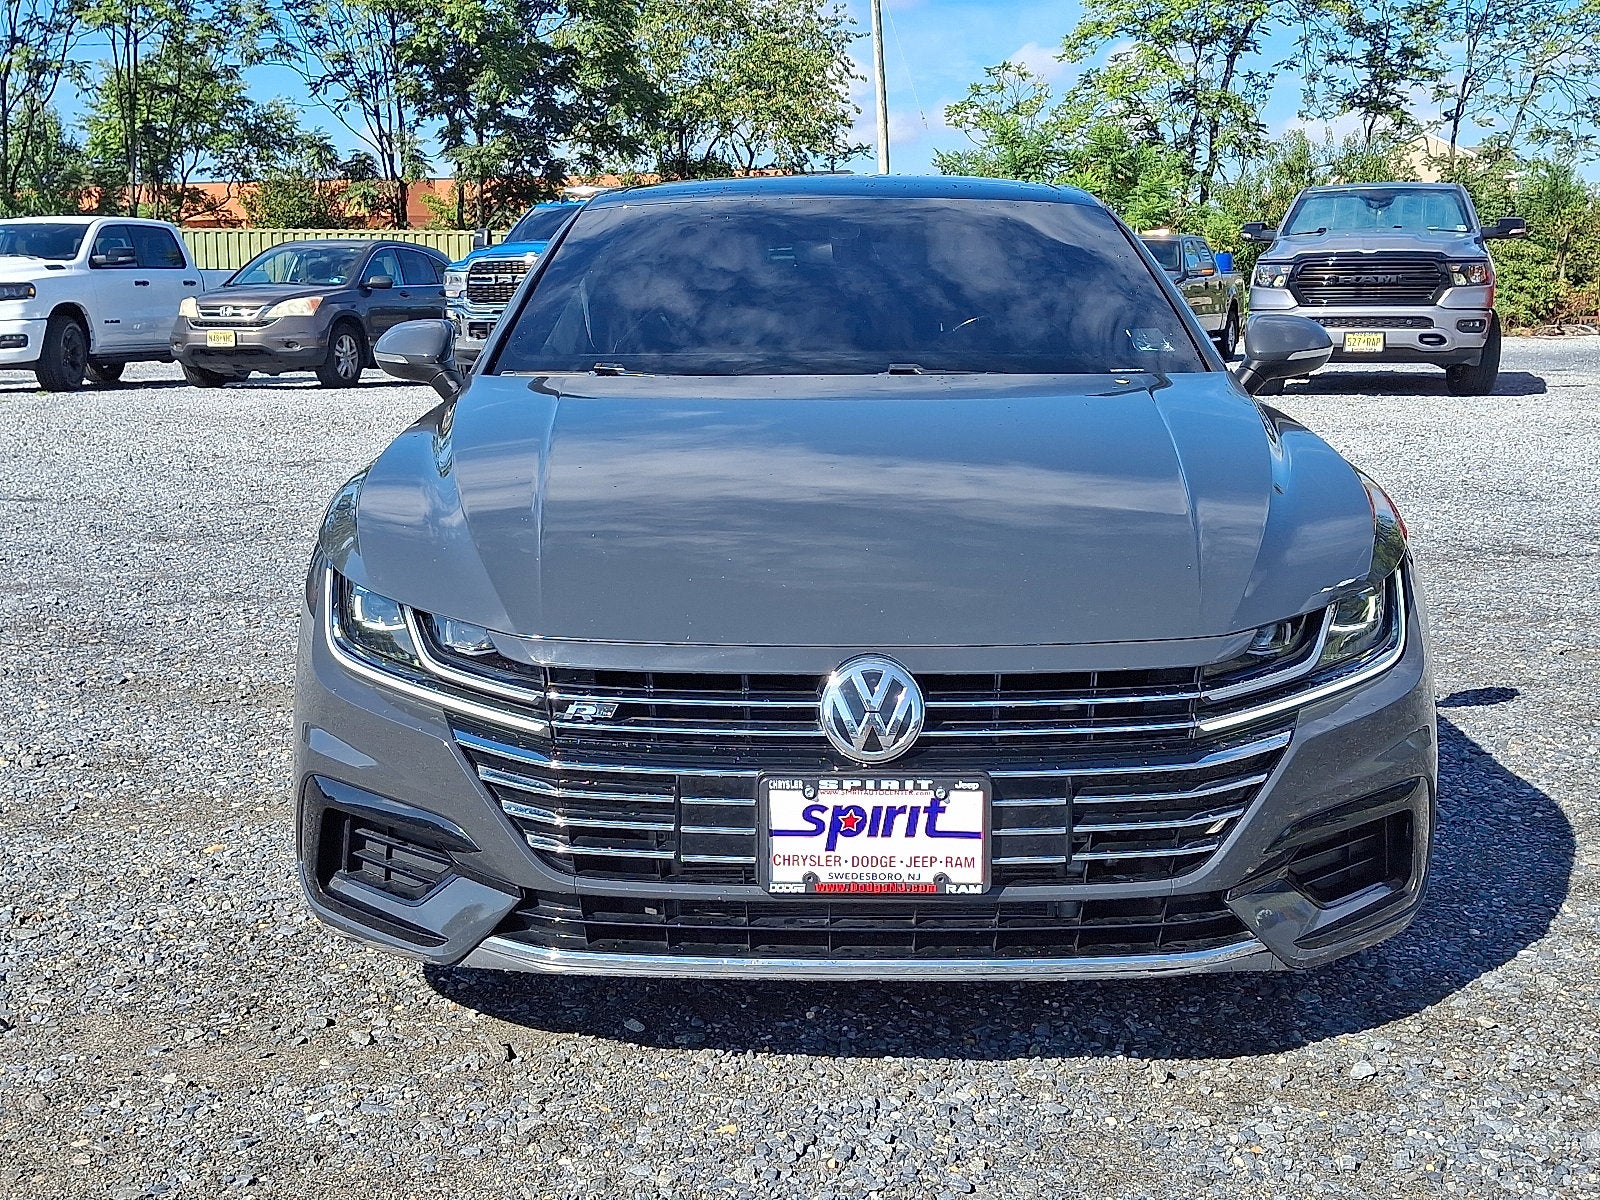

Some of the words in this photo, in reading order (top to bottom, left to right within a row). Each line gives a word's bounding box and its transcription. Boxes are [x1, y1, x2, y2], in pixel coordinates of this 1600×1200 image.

[1336, 274, 1400, 285] RAM
[768, 780, 804, 790] CHRYSLER
[818, 779, 933, 790] SPIRIT
[954, 780, 980, 791] Jeep
[802, 798, 947, 852] spirit
[772, 853, 842, 868] CHRYSLER
[851, 855, 897, 868] DODGE
[905, 856, 938, 869] JEEP
[945, 857, 975, 869] RAM
[827, 872, 905, 882] SWEDESBORO,
[907, 873, 922, 881] NJ
[769, 883, 807, 893] DODGE
[814, 881, 938, 894] www.DodgeNJ.com
[945, 884, 983, 894] RAM
